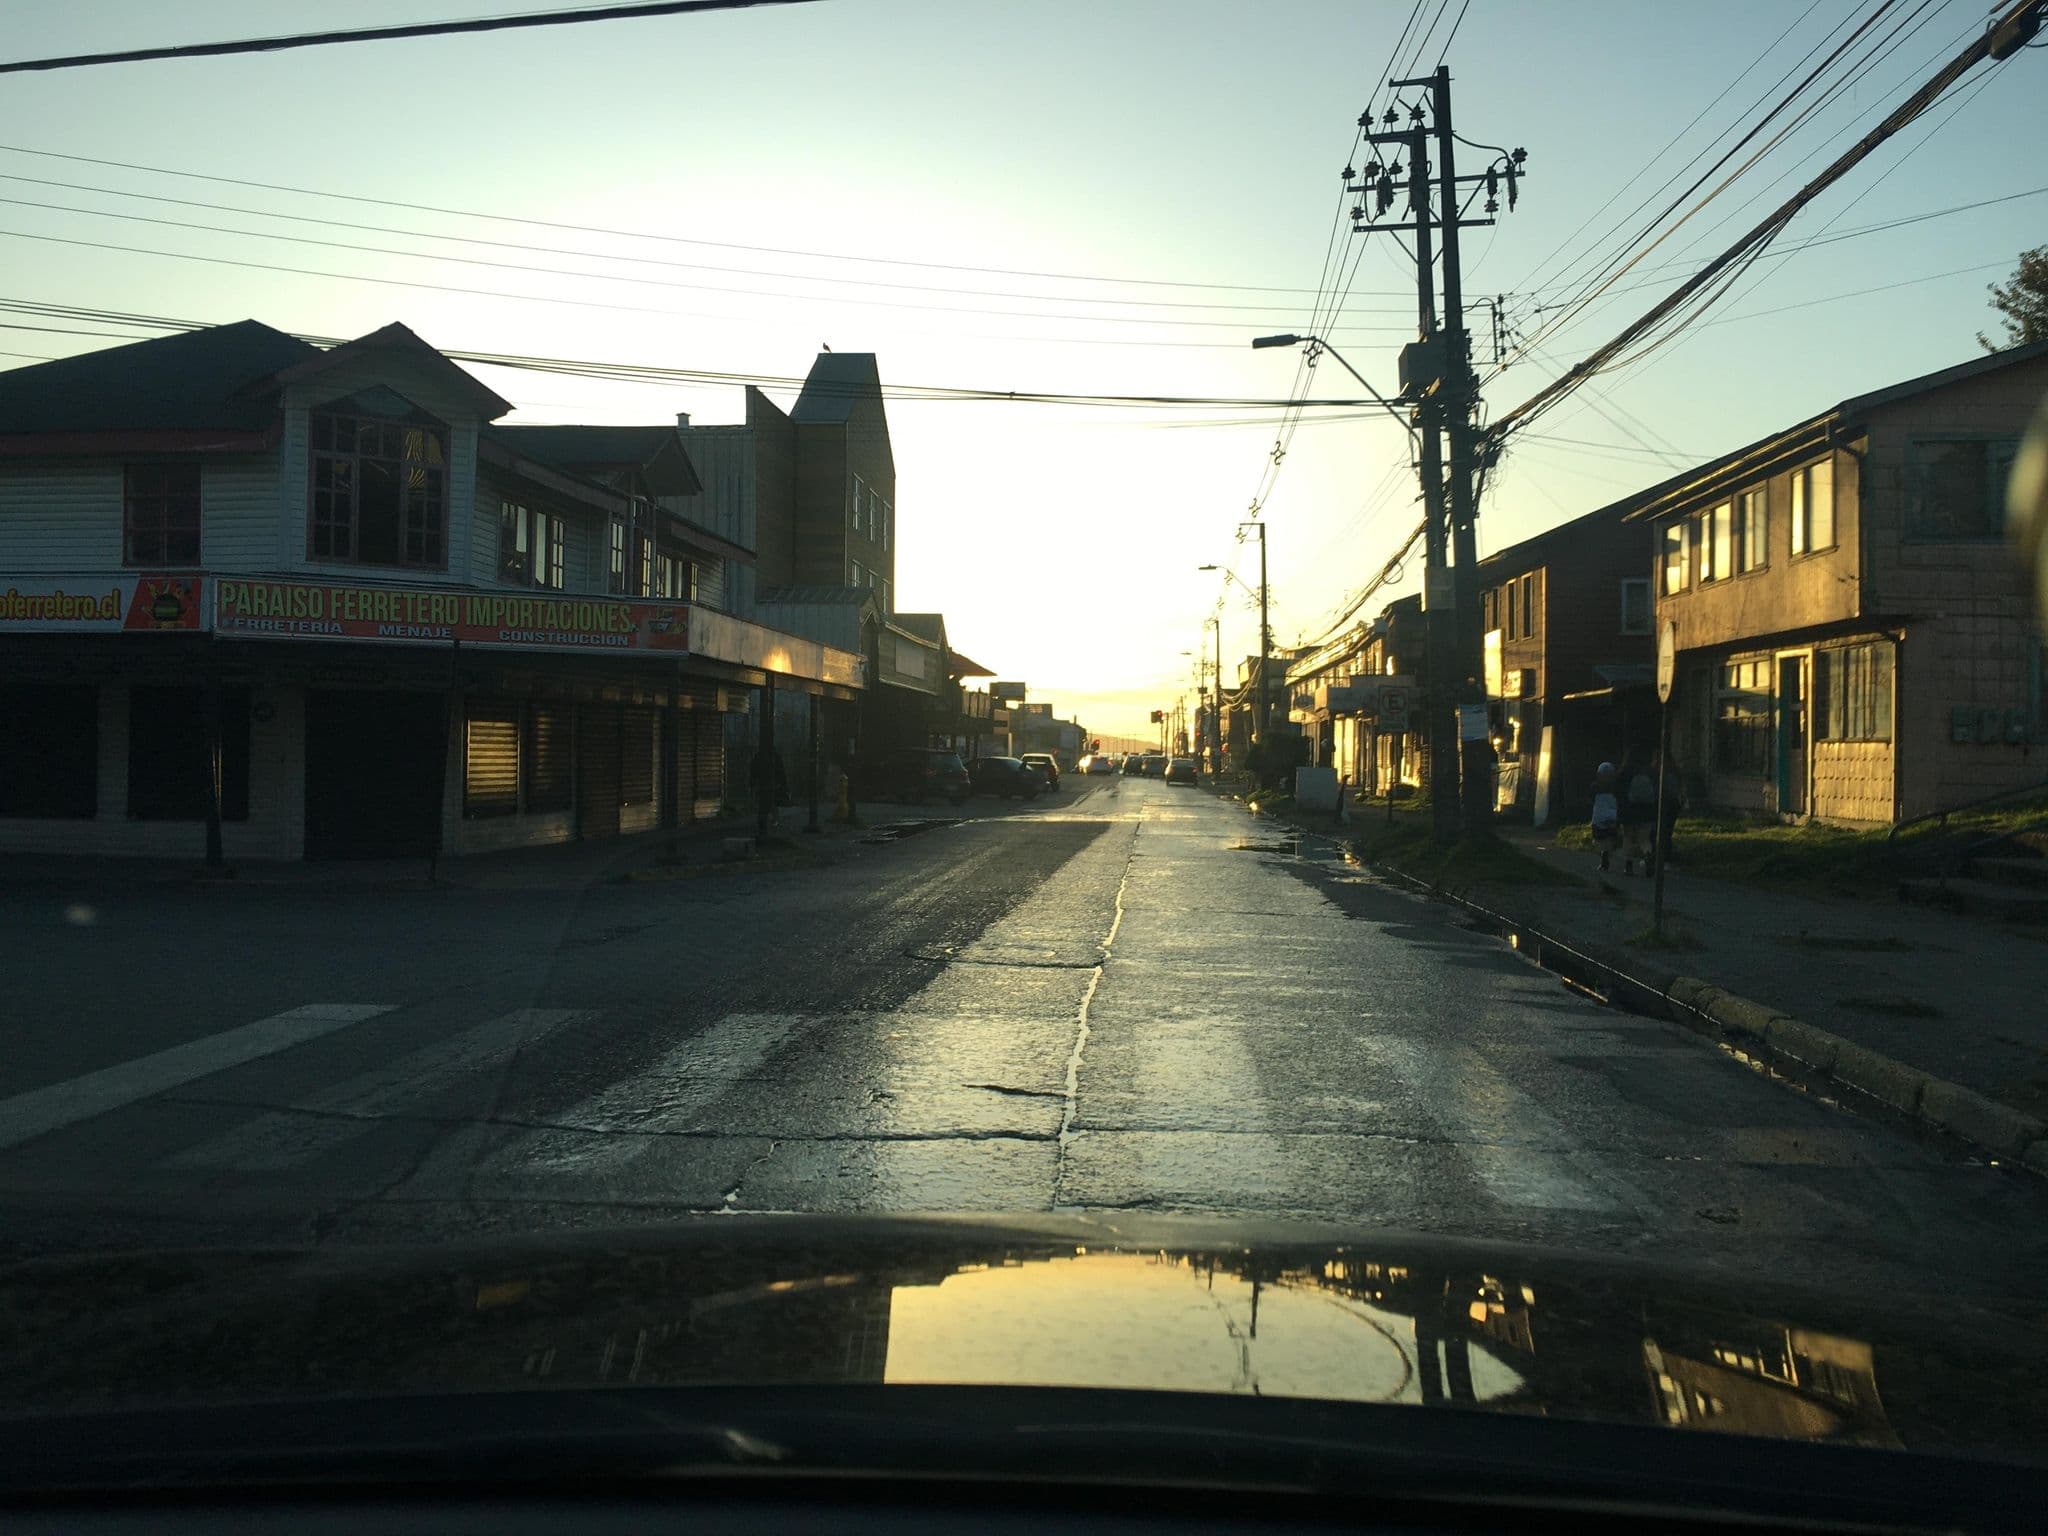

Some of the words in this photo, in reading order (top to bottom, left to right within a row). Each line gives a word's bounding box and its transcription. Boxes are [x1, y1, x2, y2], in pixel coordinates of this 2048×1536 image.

[221, 582, 324, 618] PARAISO
[330, 588, 461, 625] FERRETERO
[465, 596, 631, 632] IMPORTACIONES
[379, 624, 452, 638] MENAJE
[1388, 695, 1401, 710] E
